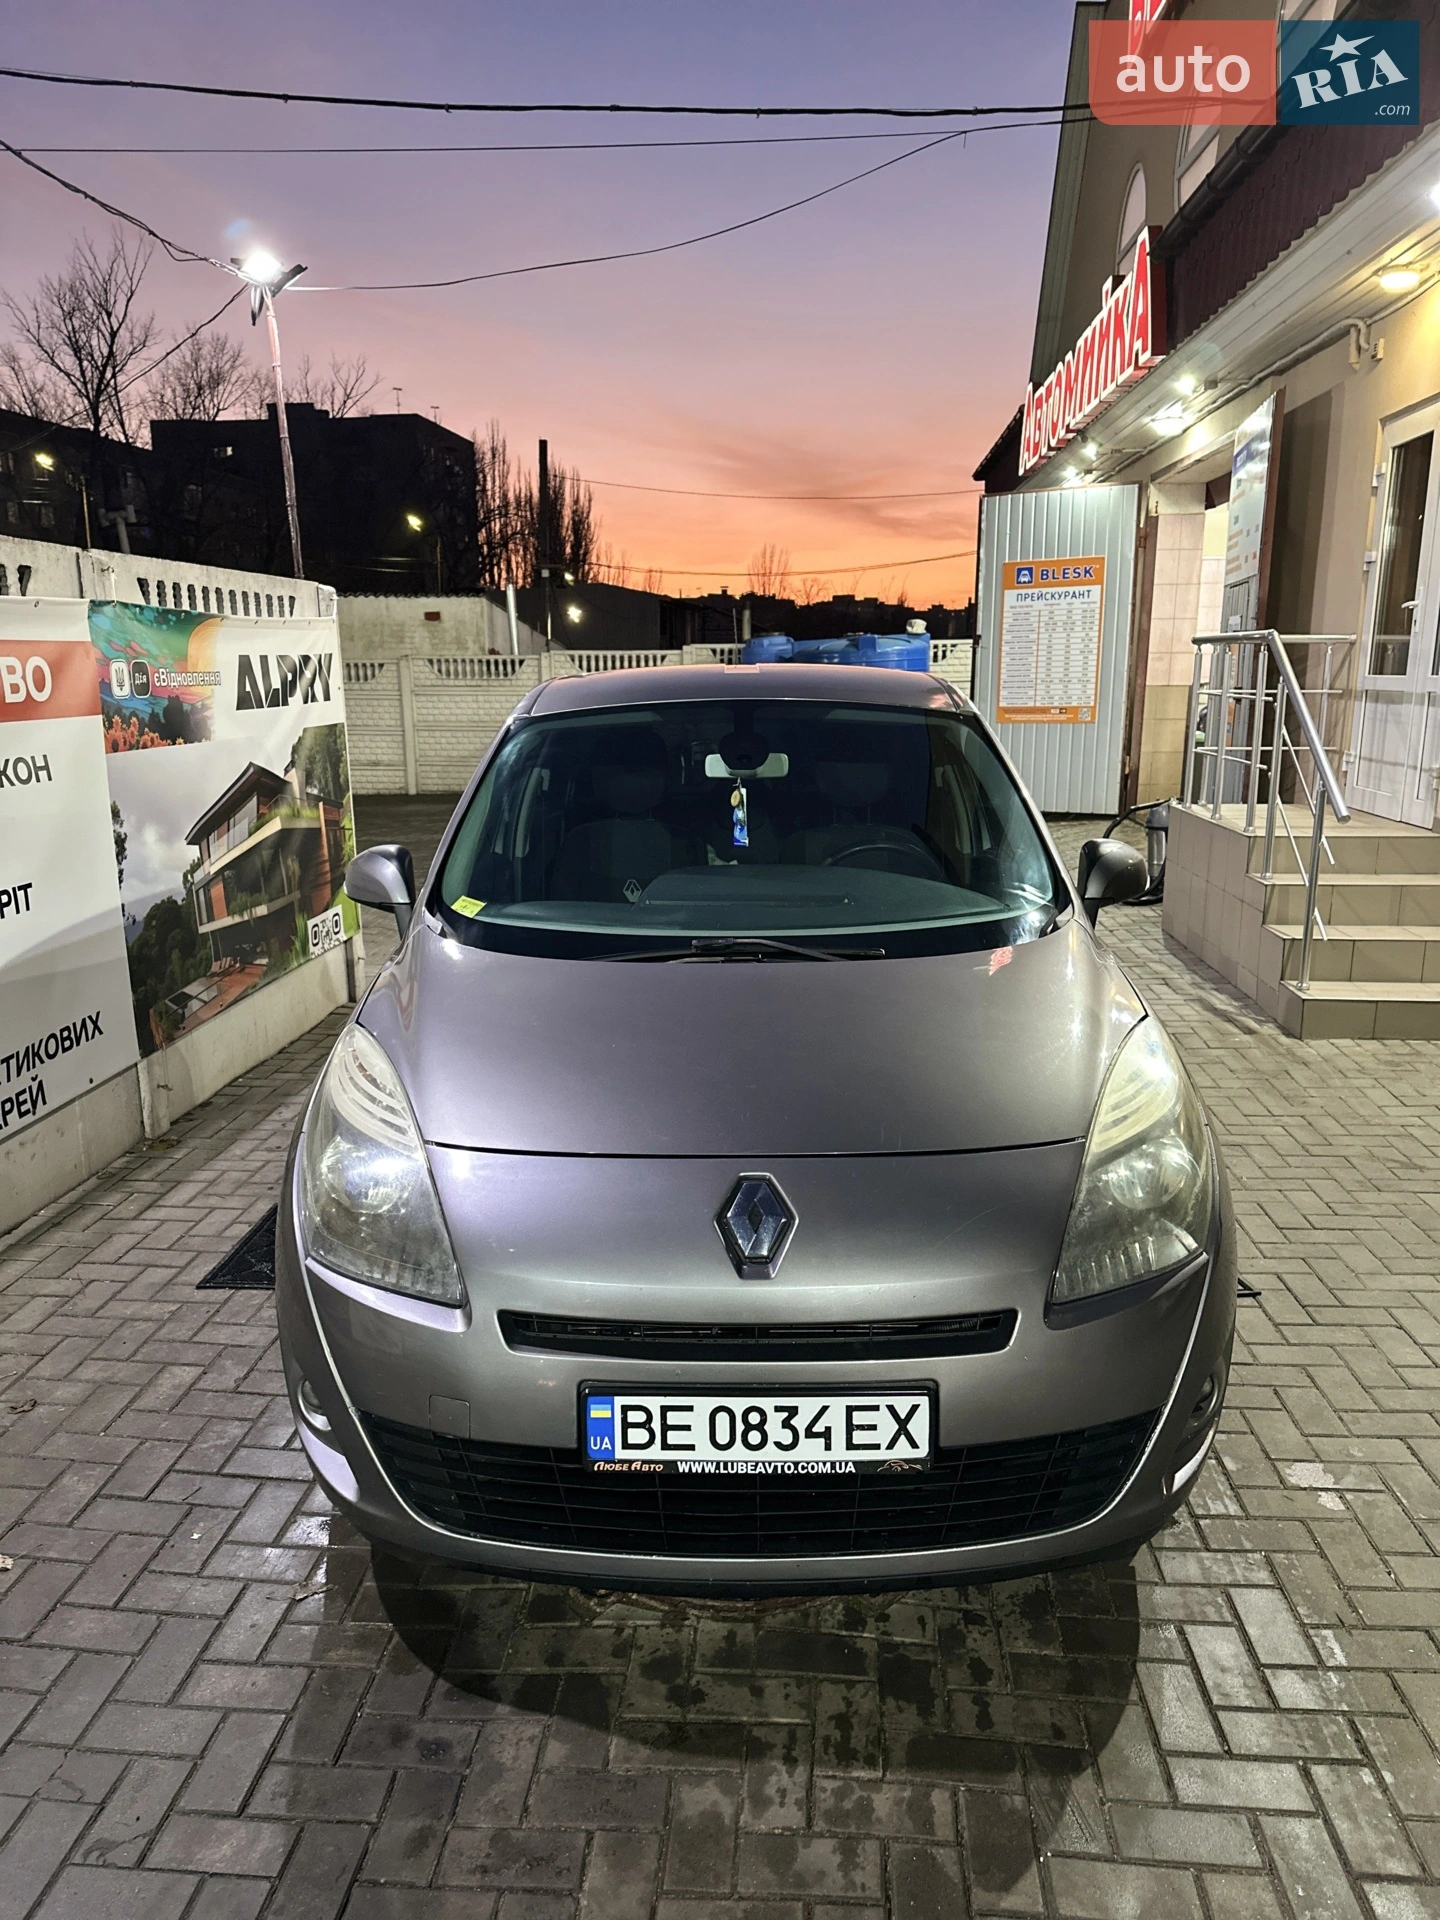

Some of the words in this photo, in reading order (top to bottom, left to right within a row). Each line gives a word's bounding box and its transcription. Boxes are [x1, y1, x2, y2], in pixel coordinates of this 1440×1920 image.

[1018, 226, 1152, 477] АВТОМИЙКА
[1039, 565, 1095, 581] BLESK
[1016, 589, 1092, 602] ПРЕЙСКУРАНТ
[154, 668, 221, 688] єВідновлення
[0, 1011, 104, 1086] ТИКОВИХ
[0, 1074, 47, 1130] РЕЙ
[708, 1404, 832, 1452] 0834
[590, 1436, 612, 1450] UA
[677, 1461, 856, 1474] WWW.LUBEAVTO.COM.UA
